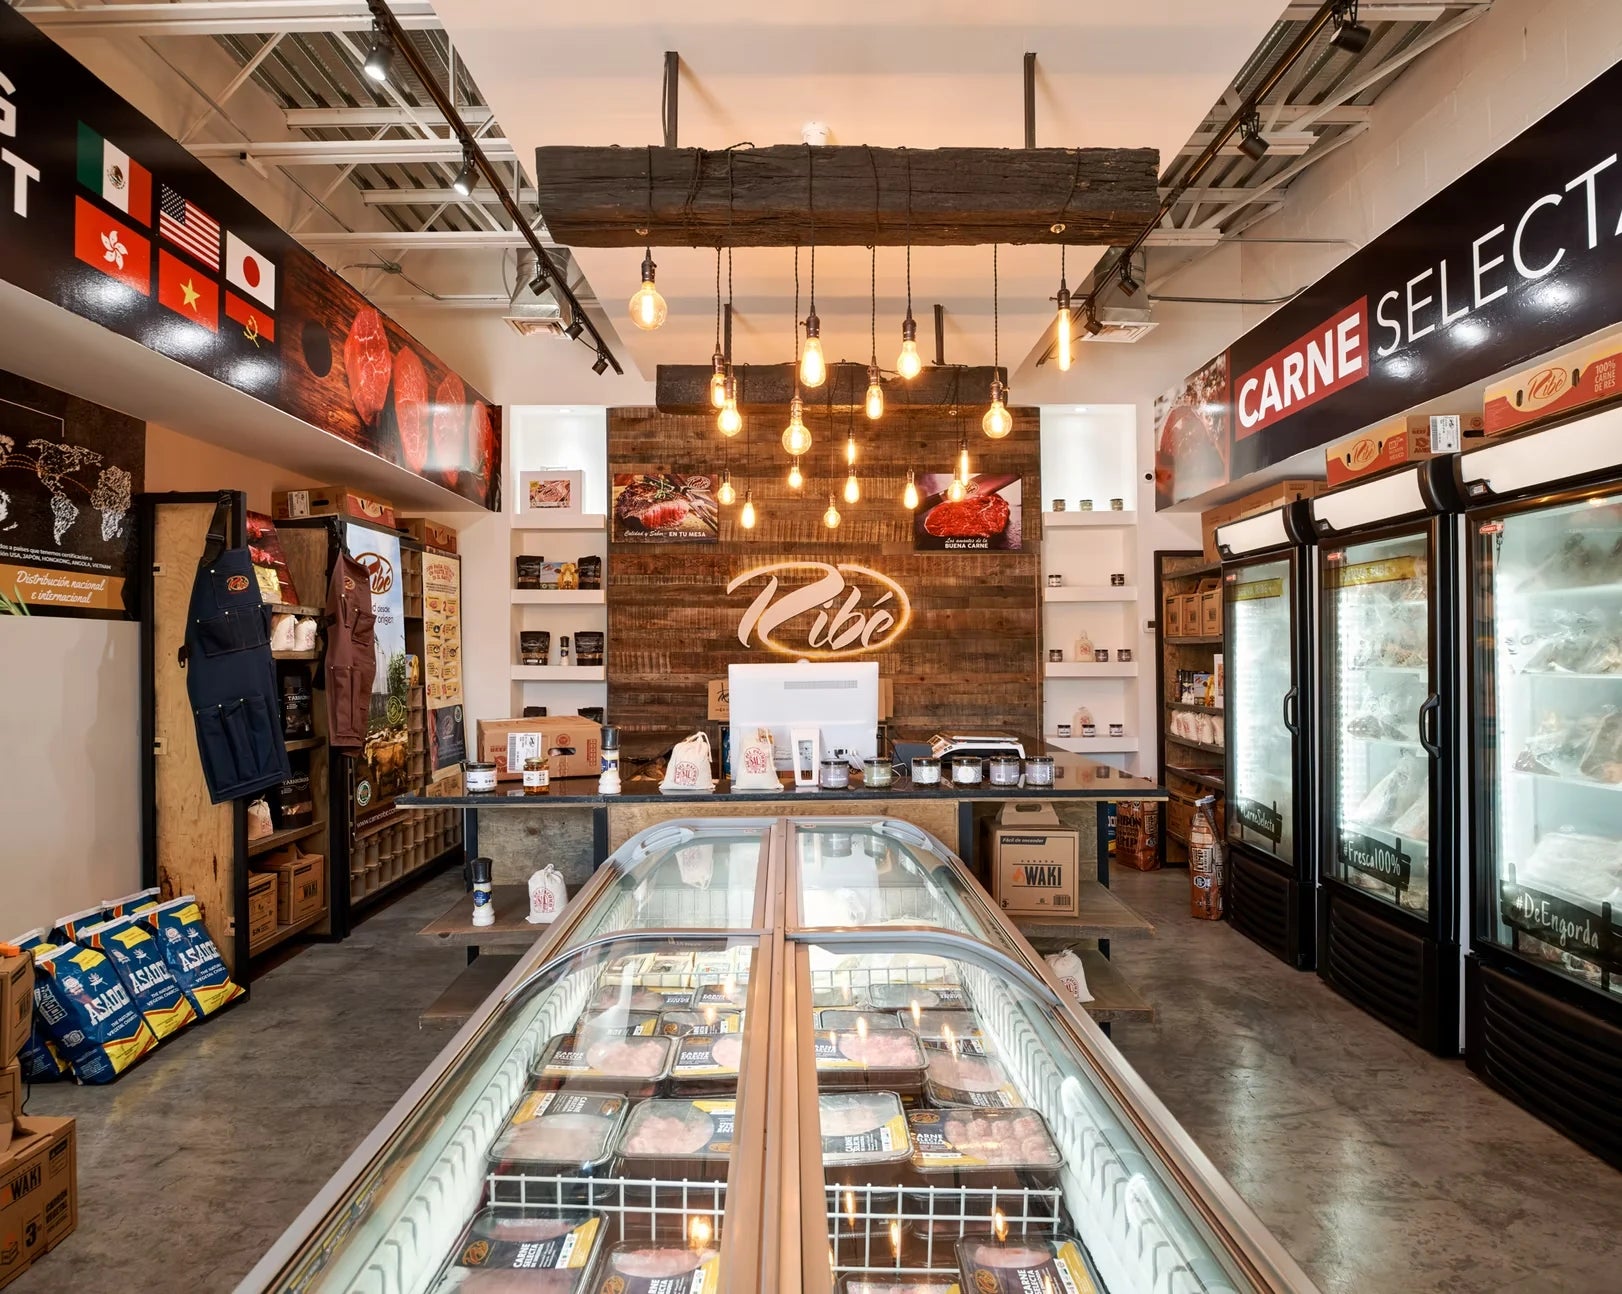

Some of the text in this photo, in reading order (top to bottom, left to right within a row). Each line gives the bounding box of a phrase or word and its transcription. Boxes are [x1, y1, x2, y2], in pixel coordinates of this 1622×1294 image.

[1238, 153, 1622, 429] CARNE SELECT
[1594, 370, 1617, 384] CARNE
[1595, 359, 1617, 374] 100%
[1594, 381, 1616, 393] DE RES
[16, 570, 106, 591] Distribución nacional
[37, 589, 93, 604] internacional
[726, 561, 911, 658] Ribé
[1343, 840, 1401, 876] #Fresca100%
[1024, 865, 1062, 886] WAKI
[1515, 892, 1600, 949] #DeEngorda
[11, 1165, 42, 1200] WAKI
[25, 1221, 37, 1248] 3
[512, 1243, 531, 1268] CARNE
[522, 1243, 540, 1268] SELECTA
